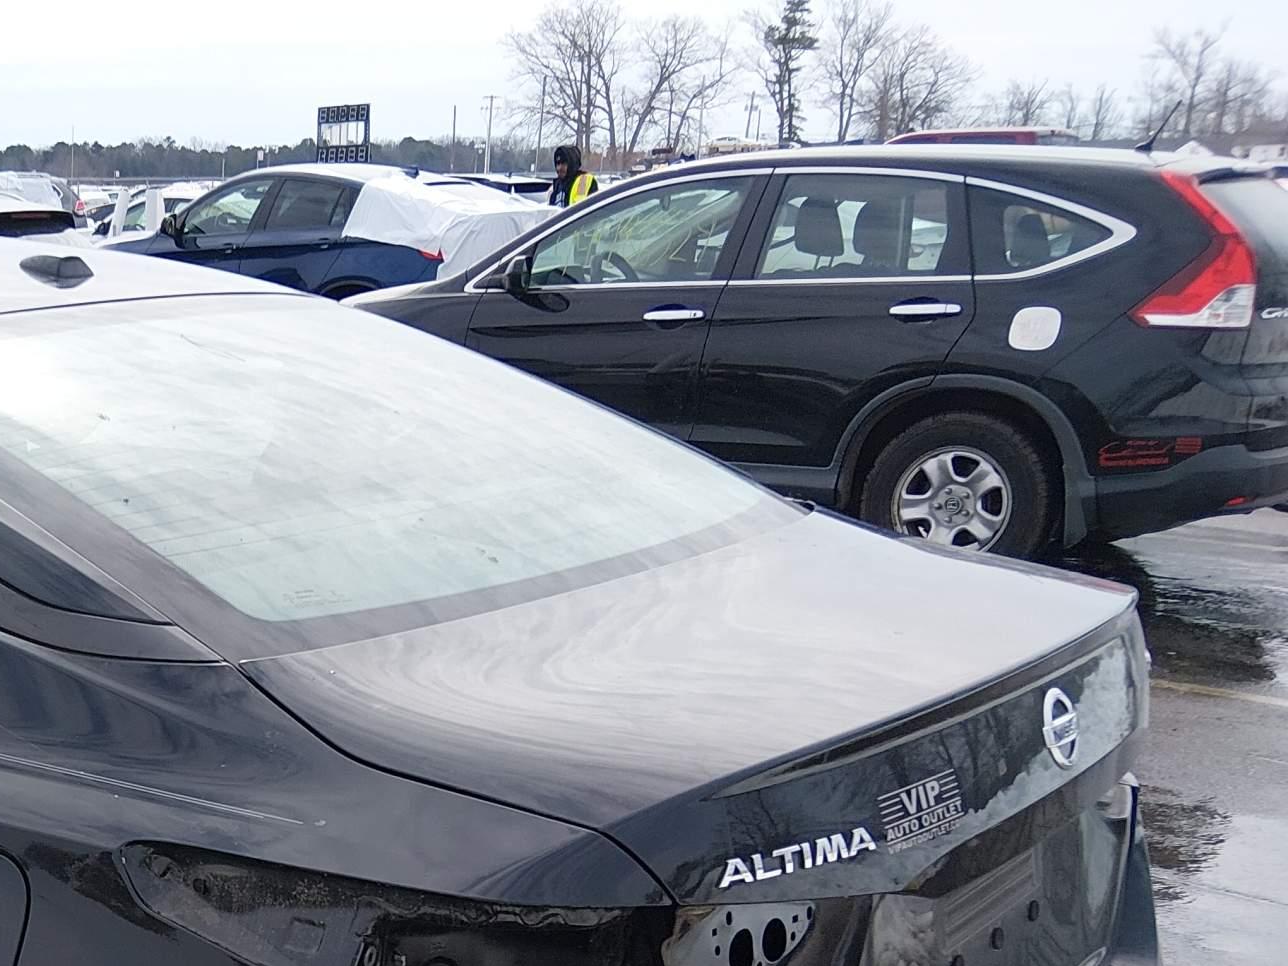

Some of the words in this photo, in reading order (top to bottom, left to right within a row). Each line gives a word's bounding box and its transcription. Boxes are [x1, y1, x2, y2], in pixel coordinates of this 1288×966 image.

[900, 780, 940, 815] VIP
[887, 819, 919, 841] AUTO
[922, 800, 962, 826] OUTLET
[719, 826, 877, 888] ALTIMA
